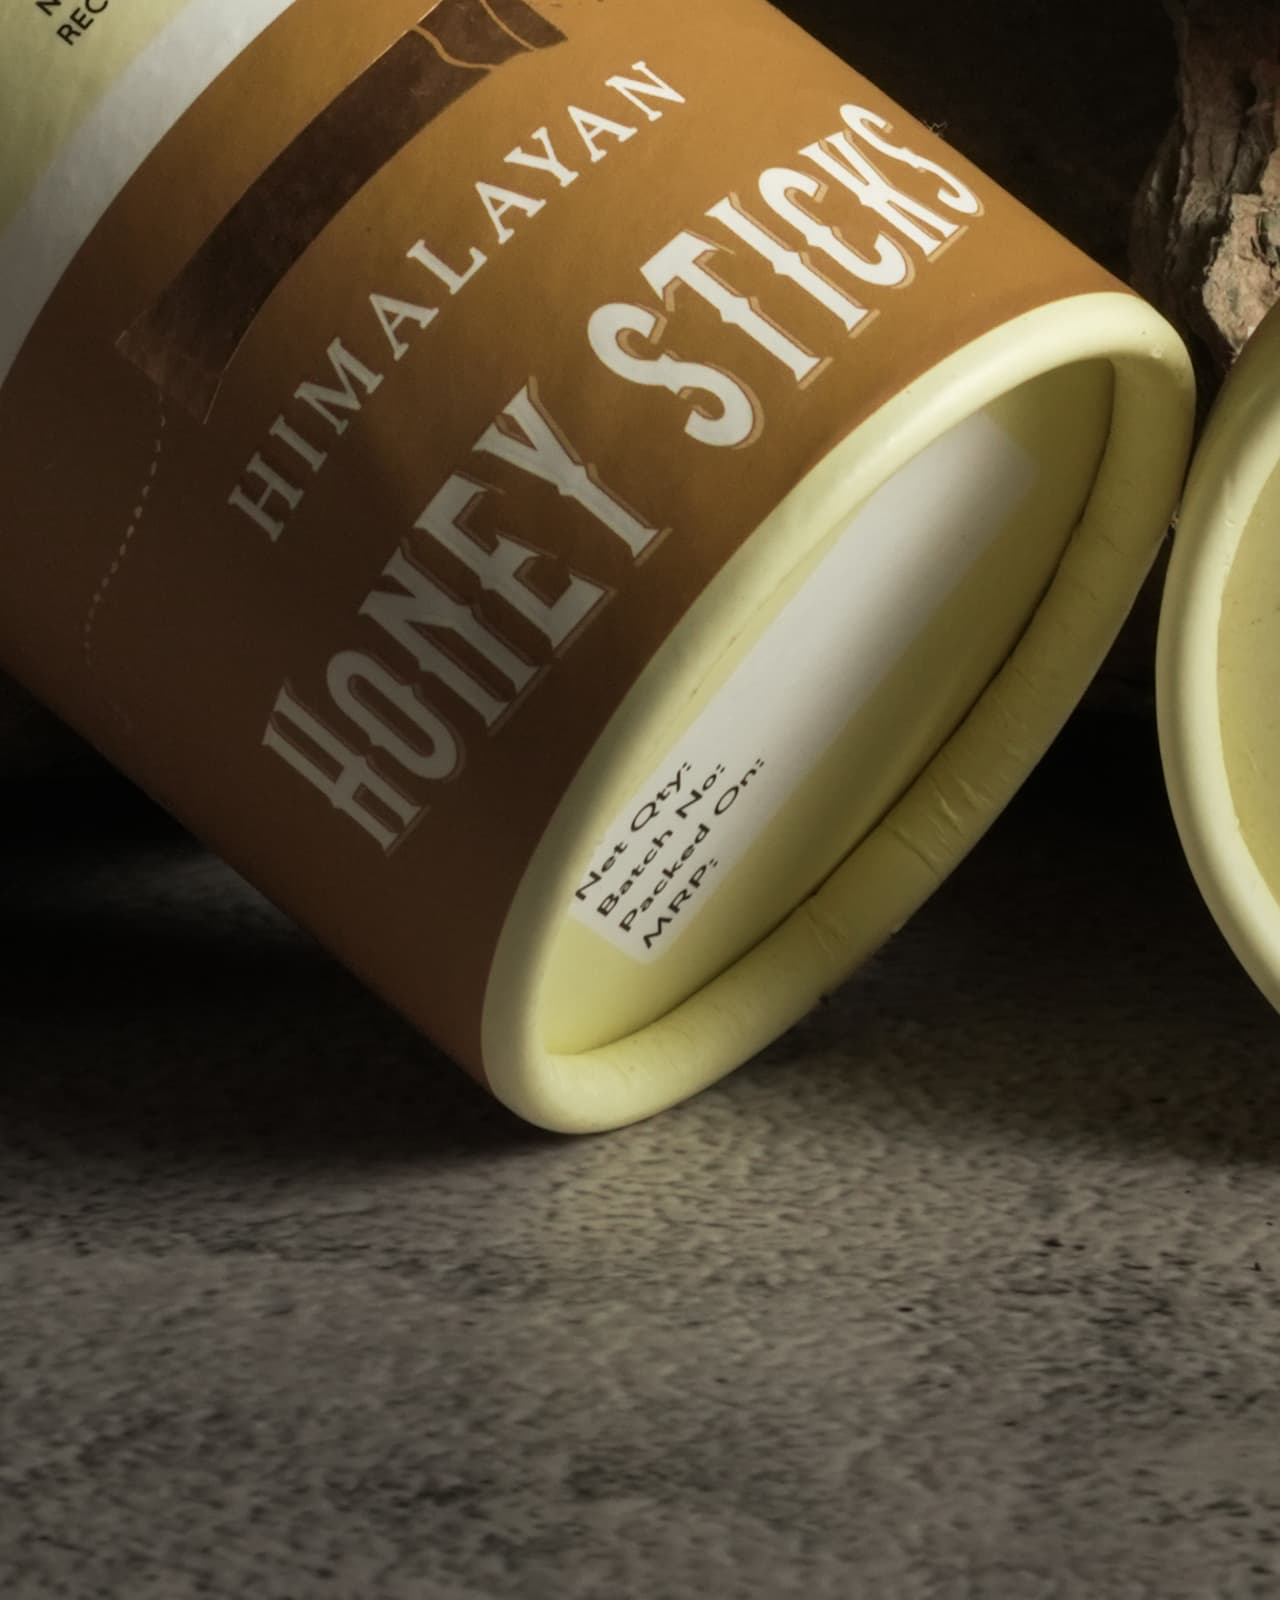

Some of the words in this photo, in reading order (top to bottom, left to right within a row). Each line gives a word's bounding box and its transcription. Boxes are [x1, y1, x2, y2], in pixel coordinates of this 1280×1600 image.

[228, 60, 687, 543] HIMALAYAN
[261, 376, 673, 857] HONEY
[587, 103, 986, 449] STICKS
[575, 841, 628, 900] Net
[631, 762, 691, 832] Qty:
[597, 830, 673, 917] Batch
[675, 764, 725, 818] No:
[619, 824, 710, 932] Packed
[714, 759, 764, 815] On:
[643, 858, 719, 949] MRP:
